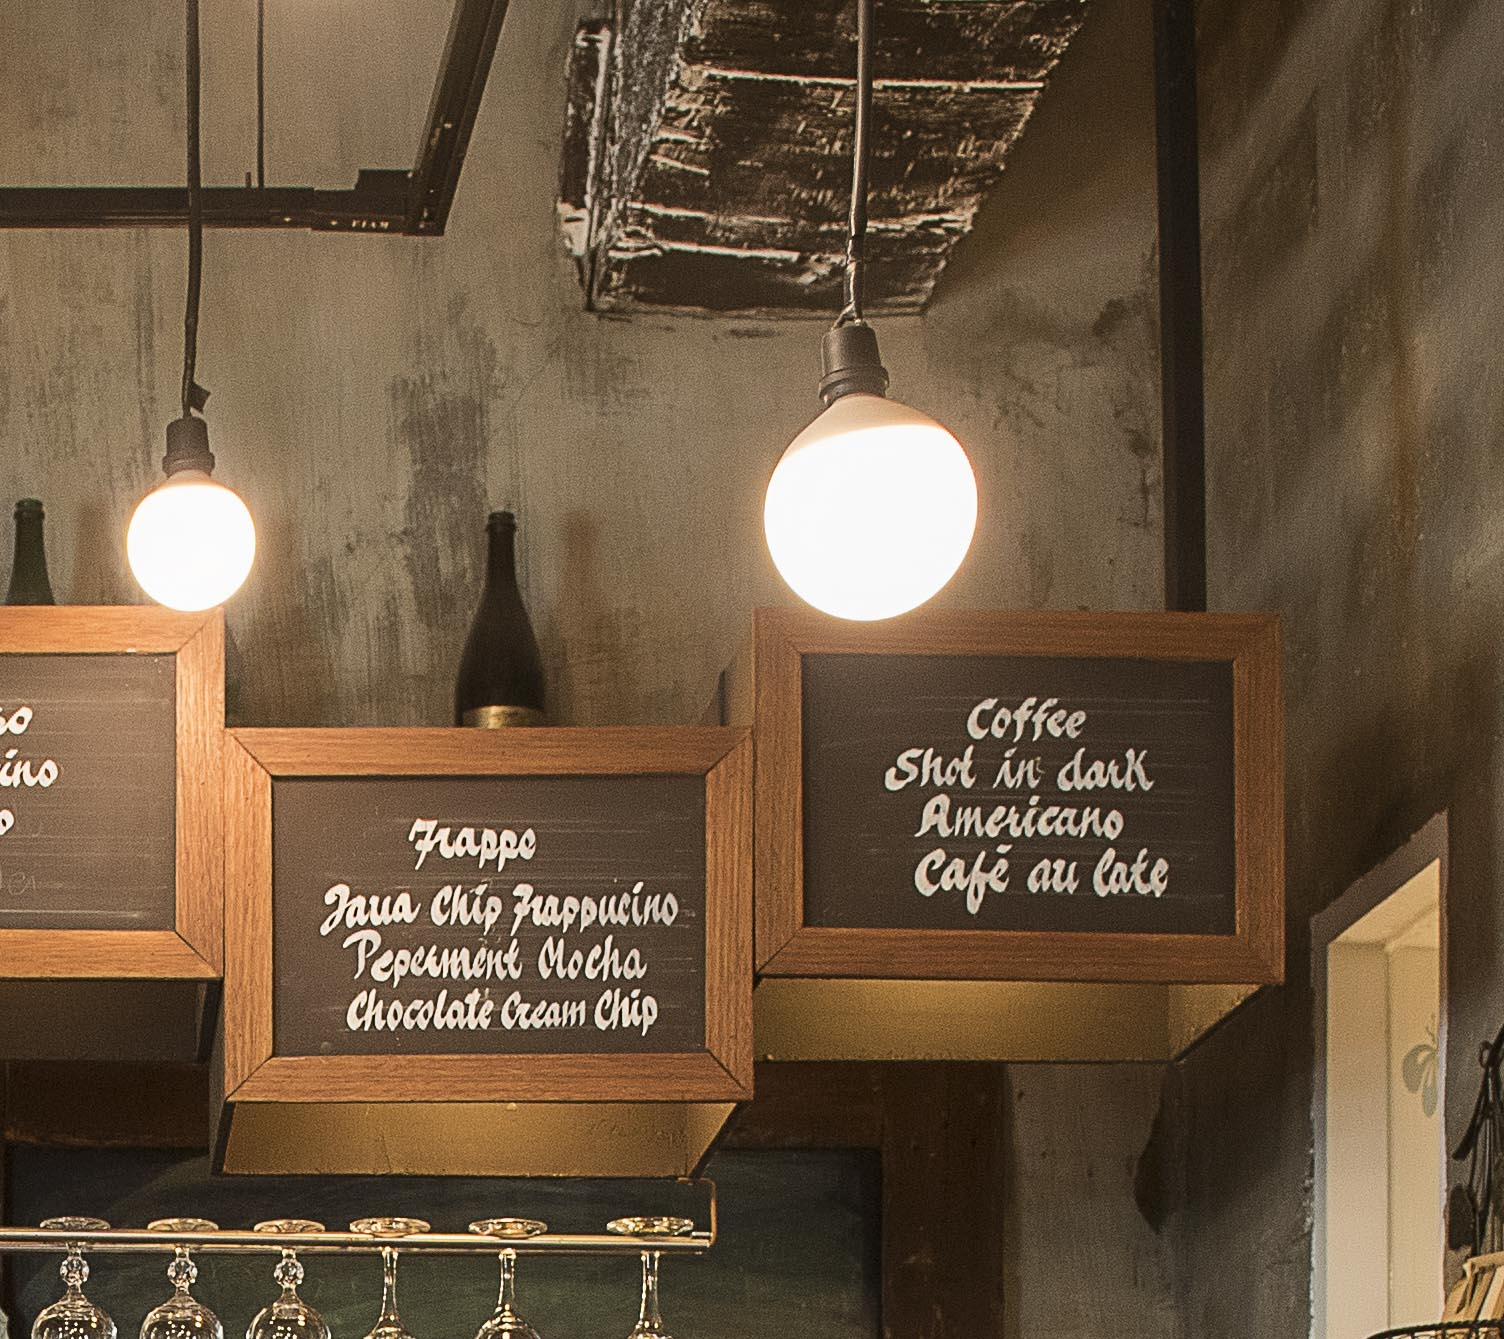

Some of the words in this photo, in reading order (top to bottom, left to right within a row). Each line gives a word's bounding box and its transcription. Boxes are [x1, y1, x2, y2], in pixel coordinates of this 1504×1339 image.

[966, 697, 1087, 742] Coffee
[885, 745, 977, 791] Shot
[992, 748, 1041, 789] in
[914, 794, 1125, 840] Americano
[408, 818, 536, 872] Frappe
[914, 844, 1013, 915] Café
[1027, 858, 1080, 894] au
[1093, 847, 1169, 898] late
[320, 883, 420, 936] Java
[430, 884, 502, 935] Chip
[510, 881, 679, 935] Frappucino
[537, 935, 648, 982] Mocha
[346, 988, 493, 1032] Chocolate
[500, 991, 586, 1030] Cream
[593, 988, 659, 1036] Chip
